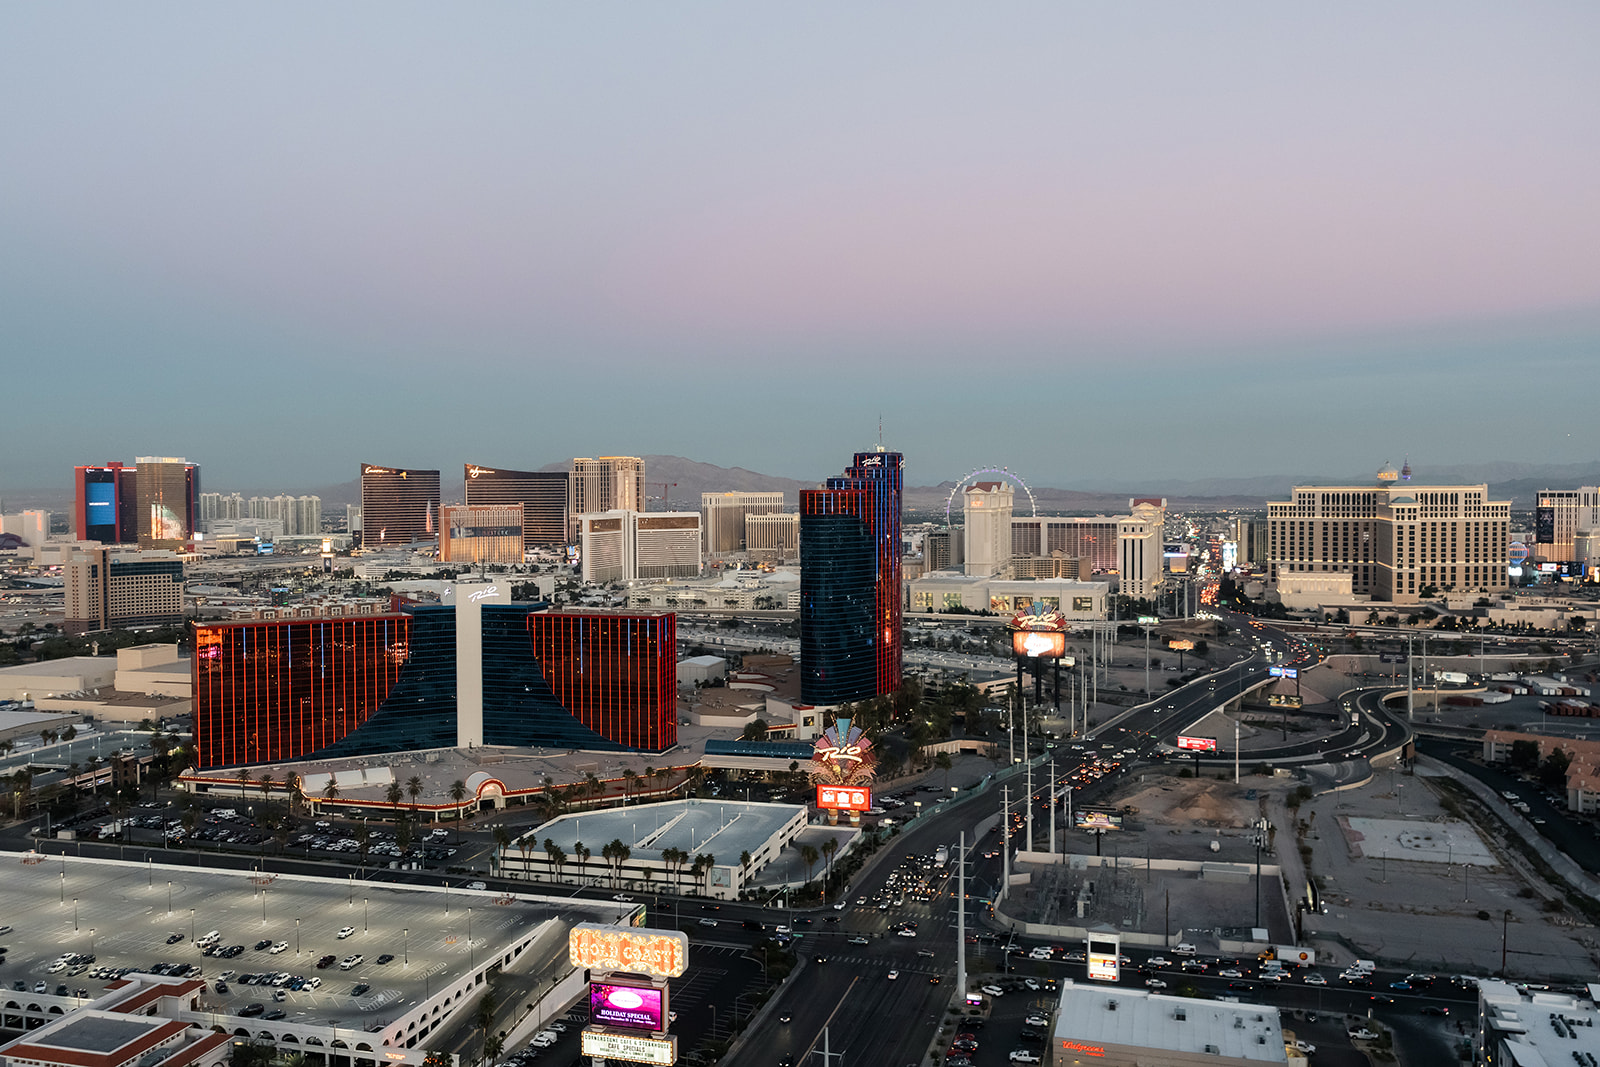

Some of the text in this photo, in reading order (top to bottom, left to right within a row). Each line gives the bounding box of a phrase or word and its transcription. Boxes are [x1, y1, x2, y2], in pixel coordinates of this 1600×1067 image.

[861, 456, 882, 467] Rio
[467, 585, 500, 603] Rio
[1017, 612, 1058, 629] Rio
[819, 743, 862, 763] Rio
[579, 943, 672, 963] GOLD COAST
[600, 1009, 651, 1020] HOLIDAY SPECIAL
[1062, 1040, 1105, 1053] Walgreens
